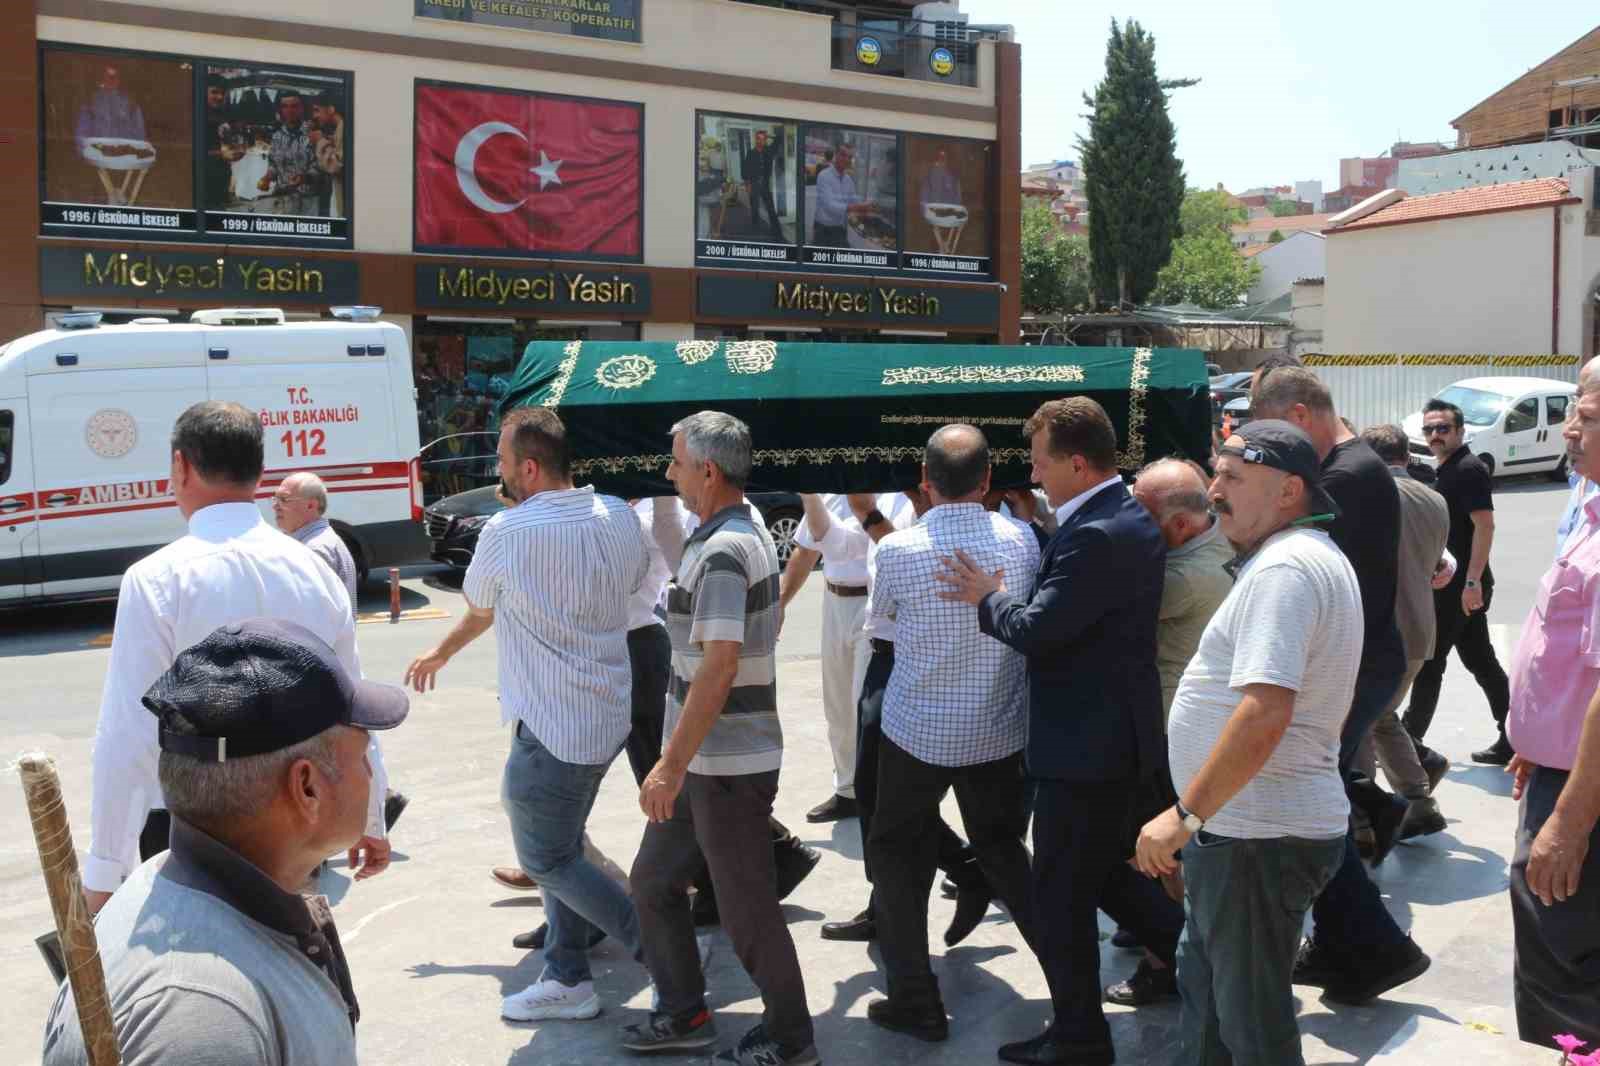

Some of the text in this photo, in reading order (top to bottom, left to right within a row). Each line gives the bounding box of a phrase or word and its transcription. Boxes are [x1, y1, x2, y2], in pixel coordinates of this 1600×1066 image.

[491, 3, 546, 18] KEFALET
[62, 210, 91, 223] 1996
[98, 209, 140, 225] ÜSKÜDAR
[142, 212, 180, 228] İSKELESİ
[222, 219, 248, 231] 1999
[256, 218, 294, 233] ÜSKÜDAR
[296, 220, 331, 235] İSKELESİ
[705, 245, 725, 256] 2000
[813, 252, 831, 262] 2001
[85, 253, 323, 293] Midyeci Yasin
[438, 268, 636, 305] Midyeci Yasin
[777, 282, 940, 316] Midyeci Yasin
[287, 387, 313, 405] T.C.
[260, 404, 359, 426] ĞLIK BAKANLIĞI
[281, 428, 326, 457] 112
[79, 479, 176, 505] AMBULA
